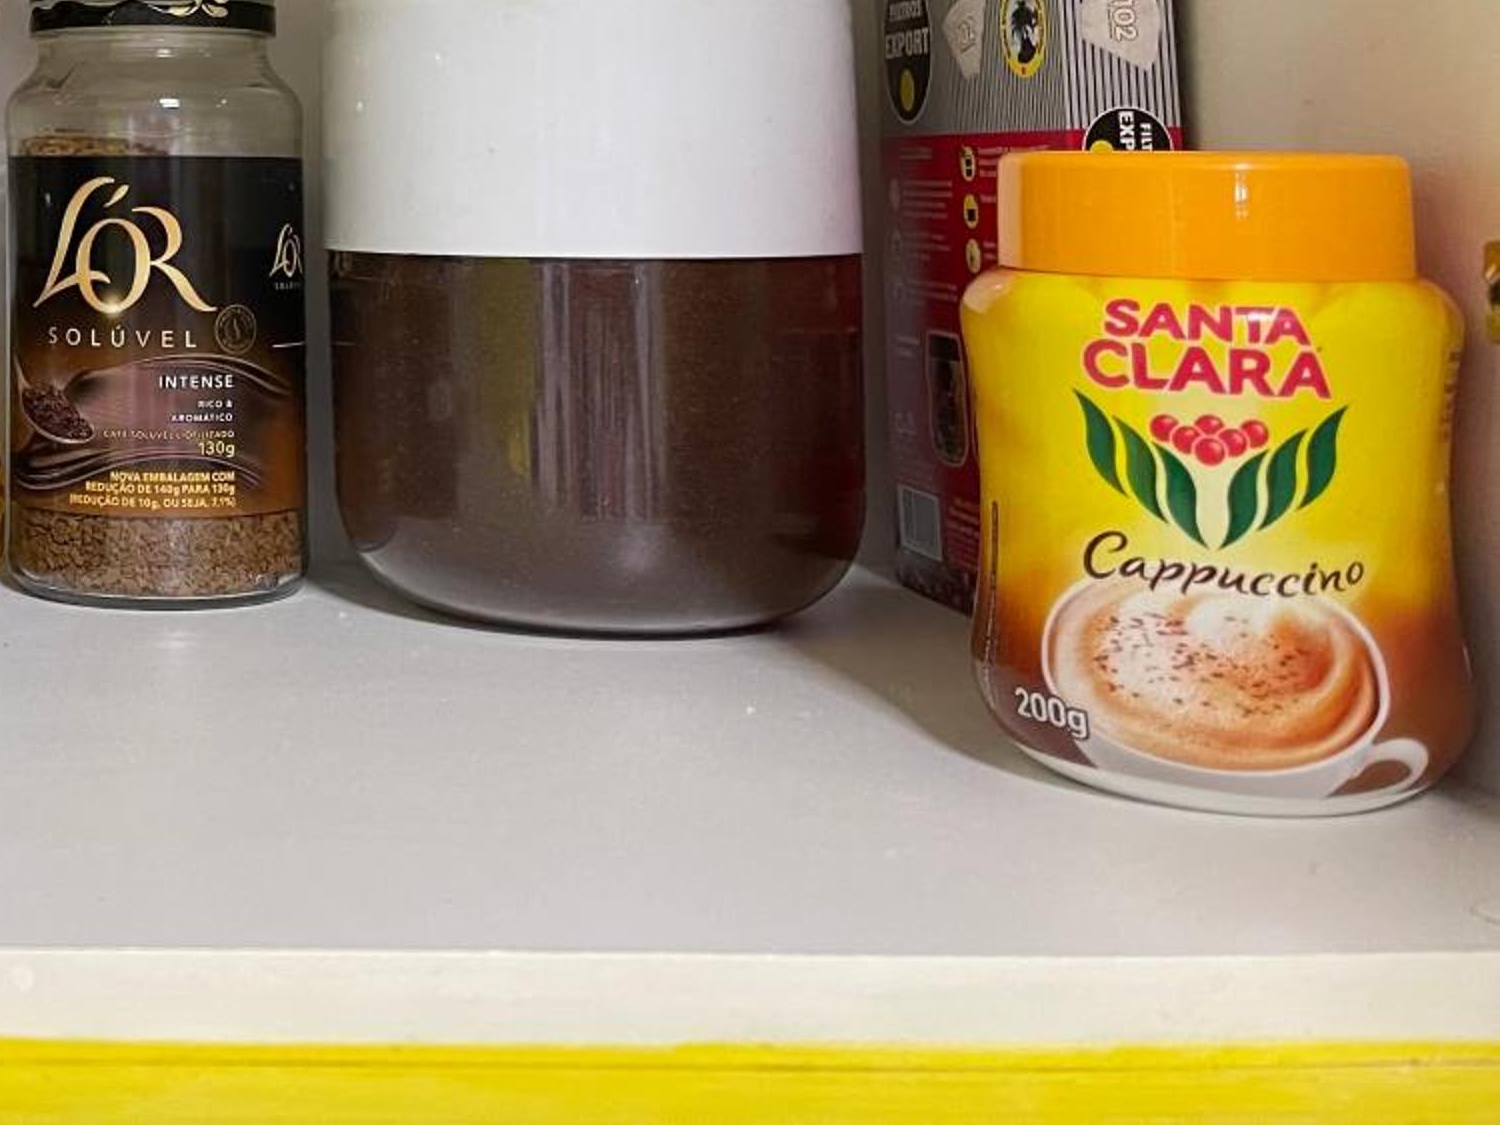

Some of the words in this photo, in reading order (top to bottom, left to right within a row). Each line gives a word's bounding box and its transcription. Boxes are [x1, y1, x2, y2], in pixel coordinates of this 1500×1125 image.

[885, 27, 928, 59] EXPORT
[1103, 298, 1312, 346] SANTA
[48, 325, 198, 349] SOLÚVEL
[1082, 337, 1334, 401] CLARA
[159, 374, 235, 390] INTENSE
[198, 441, 236, 458] 130g
[85, 480, 135, 494] REDUÇÃO
[137, 485, 151, 494] DE
[182, 484, 210, 494] PARA
[109, 471, 140, 482] NOVA
[142, 471, 210, 482] EMBALAGEM
[211, 471, 236, 482] COM
[121, 496, 136, 507] DE
[163, 498, 179, 508] OU
[1082, 529, 1366, 599] Cappuccino
[1013, 686, 1089, 740] 200g
